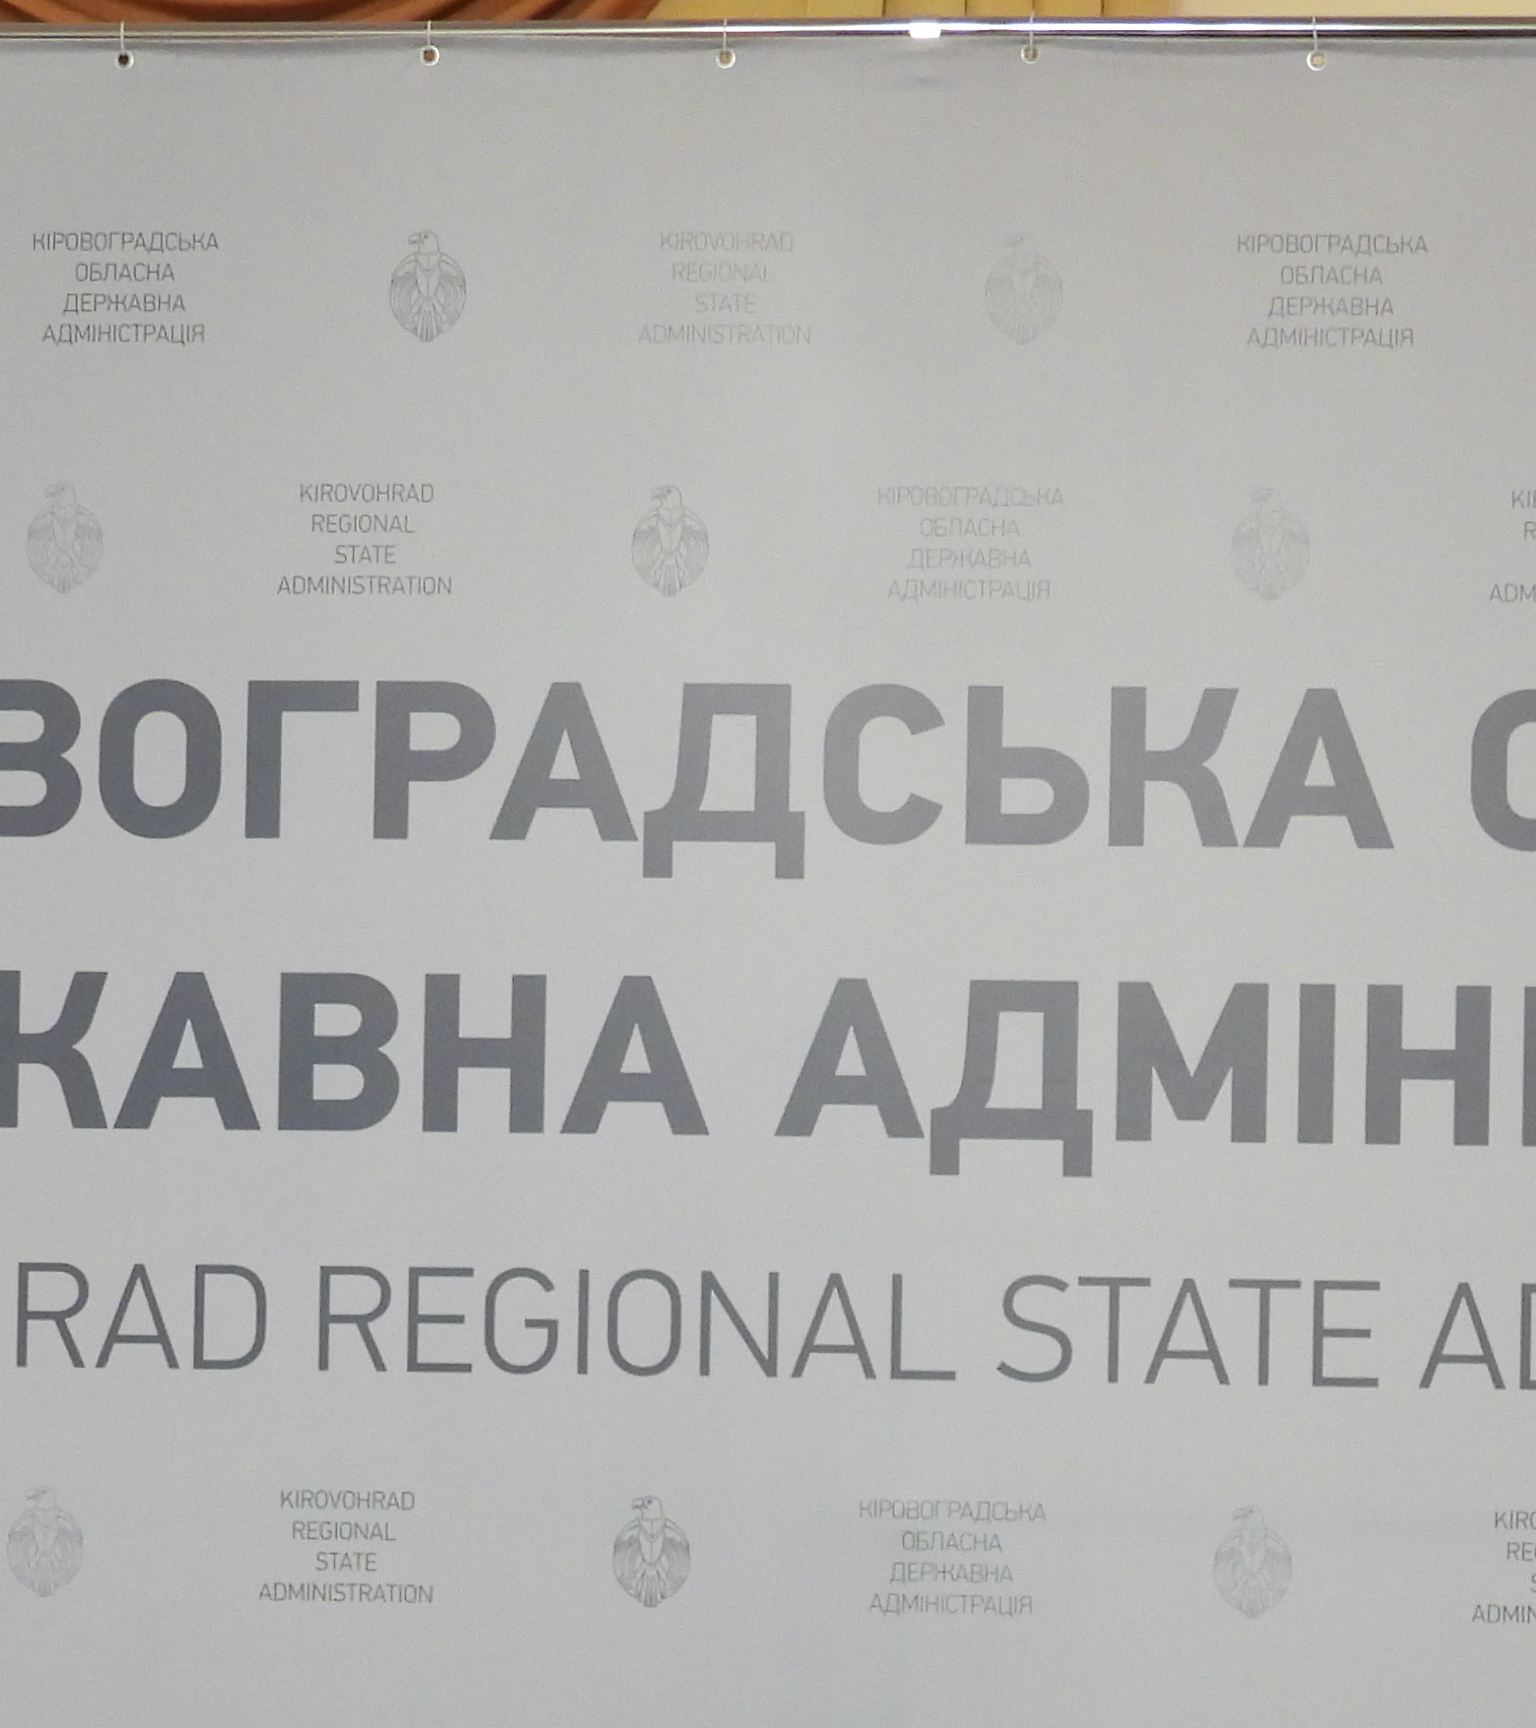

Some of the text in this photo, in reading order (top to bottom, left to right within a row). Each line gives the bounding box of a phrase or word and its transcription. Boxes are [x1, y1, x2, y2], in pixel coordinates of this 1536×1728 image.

[32, 230, 220, 255] КІРОВОГРАДСЬКА
[660, 232, 793, 251] KIROVOHRAD
[1236, 233, 1429, 257] КІРОВОГРАДСЬКА
[74, 261, 175, 283] ОБЛАСНА
[672, 263, 767, 282] REGIONAL
[1280, 265, 1383, 285] ОБЛАСНА
[61, 292, 186, 316] ДЕРЖАВНА
[696, 293, 753, 313] STATE
[1267, 295, 1394, 319] ДЕРЖАВНА
[41, 322, 206, 347] АДМІНІСТРАЦІЯ
[639, 324, 811, 344] ADMINISTRATION
[1246, 326, 1414, 350] АДМІНІСТРАЦІЯ
[299, 482, 435, 504] KIROVOHRAD
[878, 486, 1063, 508] КІРОВОГРАДСЬКА
[311, 513, 415, 534] REGIONAL
[920, 517, 1019, 537] ОБЛАСНА
[334, 544, 396, 565] STATE
[908, 548, 1031, 570] ДЕРЖАВНА
[276, 574, 452, 596] ADMINISTRATION
[888, 579, 1050, 602] АДМІНІСТРАЦІЯ
[316, 1266, 957, 1380] REGIONAL
[996, 1274, 1380, 1388] STATE
[279, 1488, 416, 1512] KIROVOHRAD
[859, 1499, 1047, 1524] КІРОВОГРАДСЬКА
[291, 1519, 397, 1542] REGIONAL
[900, 1529, 1003, 1552] ОБЛАСНА
[315, 1551, 377, 1573] STATE
[889, 1561, 1013, 1585] ДЕРЖАВНА
[258, 1581, 434, 1604] ADMINISTRATION
[869, 1592, 1033, 1618] АДМІНІСТРАЦІЯ
